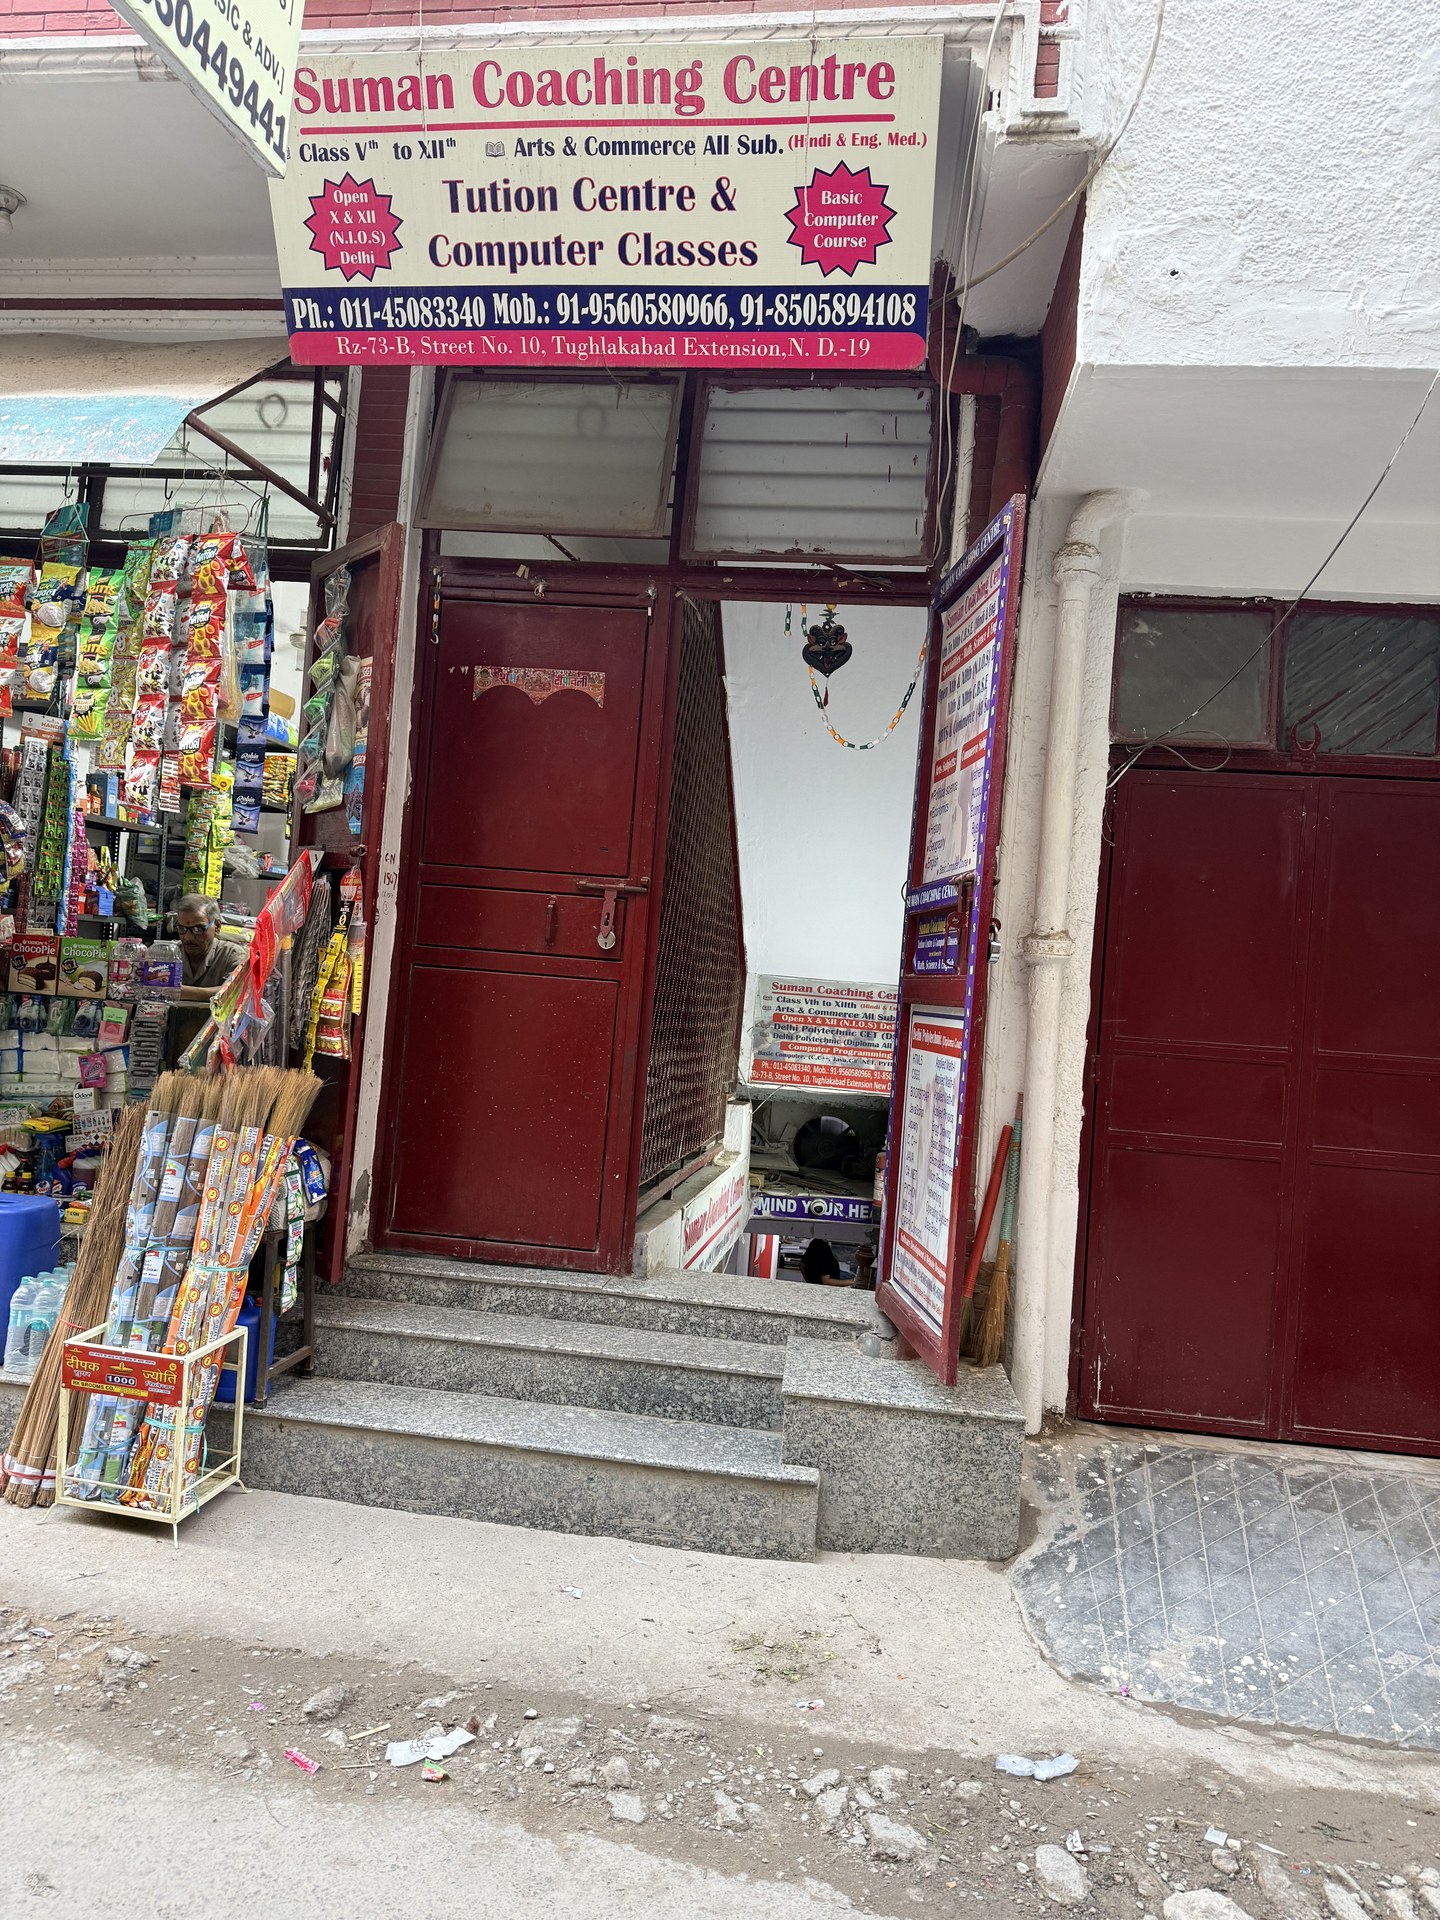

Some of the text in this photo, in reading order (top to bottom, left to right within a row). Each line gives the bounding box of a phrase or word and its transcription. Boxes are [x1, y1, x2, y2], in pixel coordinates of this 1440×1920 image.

[243, 20, 252, 50] &
[294, 53, 895, 116] Suman Coaching Centre
[299, 143, 350, 163] Class
[355, 139, 379, 161] Vth
[393, 142, 412, 160] to
[514, 137, 555, 157] Arts
[562, 136, 577, 156] &
[584, 135, 696, 157] Commerce
[703, 135, 729, 155] All
[737, 133, 784, 155] Sub.
[788, 132, 927, 151] (Hndi & Eng. Med.)
[333, 189, 368, 206] Open
[442, 175, 737, 214] Tution Centre &
[821, 191, 863, 205] Basic
[329, 209, 376, 224] X & XII
[804, 212, 878, 228] Computer
[329, 230, 386, 247] (N.I.O.S)
[813, 234, 867, 249] Course
[340, 250, 375, 265] Delhi
[428, 232, 759, 274] Computer Classes
[292, 292, 916, 330] Ph.: 011-45083340 Mob.: 91-9560580966, 91-8505894108
[335, 336, 417, 358] Rz-73-B,
[420, 335, 475, 355] Street
[480, 335, 514, 354] No.
[520, 335, 547, 358] 10,
[551, 335, 676, 361] Tughlakabad
[980, 519, 1001, 556] CENTRE
[946, 573, 989, 631] Suman Coaching
[952, 707, 975, 736] Commerce
[241, 752, 259, 761] Robin
[236, 795, 255, 805] Robin
[12, 942, 56, 955] ChocoPie
[63, 946, 107, 959] ChocoPie
[772, 982, 813, 993] Suman
[817, 985, 874, 1000] Coaching
[777, 996, 801, 1004] Class
[804, 998, 819, 1006] Vth
[834, 1000, 857, 1009] XIIth
[775, 1005, 795, 1013] Arts
[808, 1007, 860, 1019] Commerce
[774, 1023, 798, 1032] Delhi
[802, 1025, 857, 1037] Polytechnic
[860, 1030, 879, 1038] CET
[782, 1014, 804, 1022] Open
[840, 1020, 877, 1030] (N.I.O.S)
[773, 1032, 793, 1041] Delhi
[796, 1034, 841, 1045] Polytechnic
[843, 1039, 880, 1048] (Diploma
[788, 1043, 893, 1059] Computer Programming
[774, 1072, 791, 1080] Street
[792, 1073, 802, 1082] No.
[812, 1075, 845, 1086] Tughlakabad
[846, 1079, 873, 1089] Extension
[874, 1081, 886, 1090] New
[758, 1196, 797, 1213] MIND
[802, 1199, 844, 1217] YUR
[66, 1355, 101, 1372] दीपक
[107, 1376, 135, 1385] 1000
[142, 1367, 177, 1384] ज्योति
[81, 1381, 104, 1390] BROOMS
